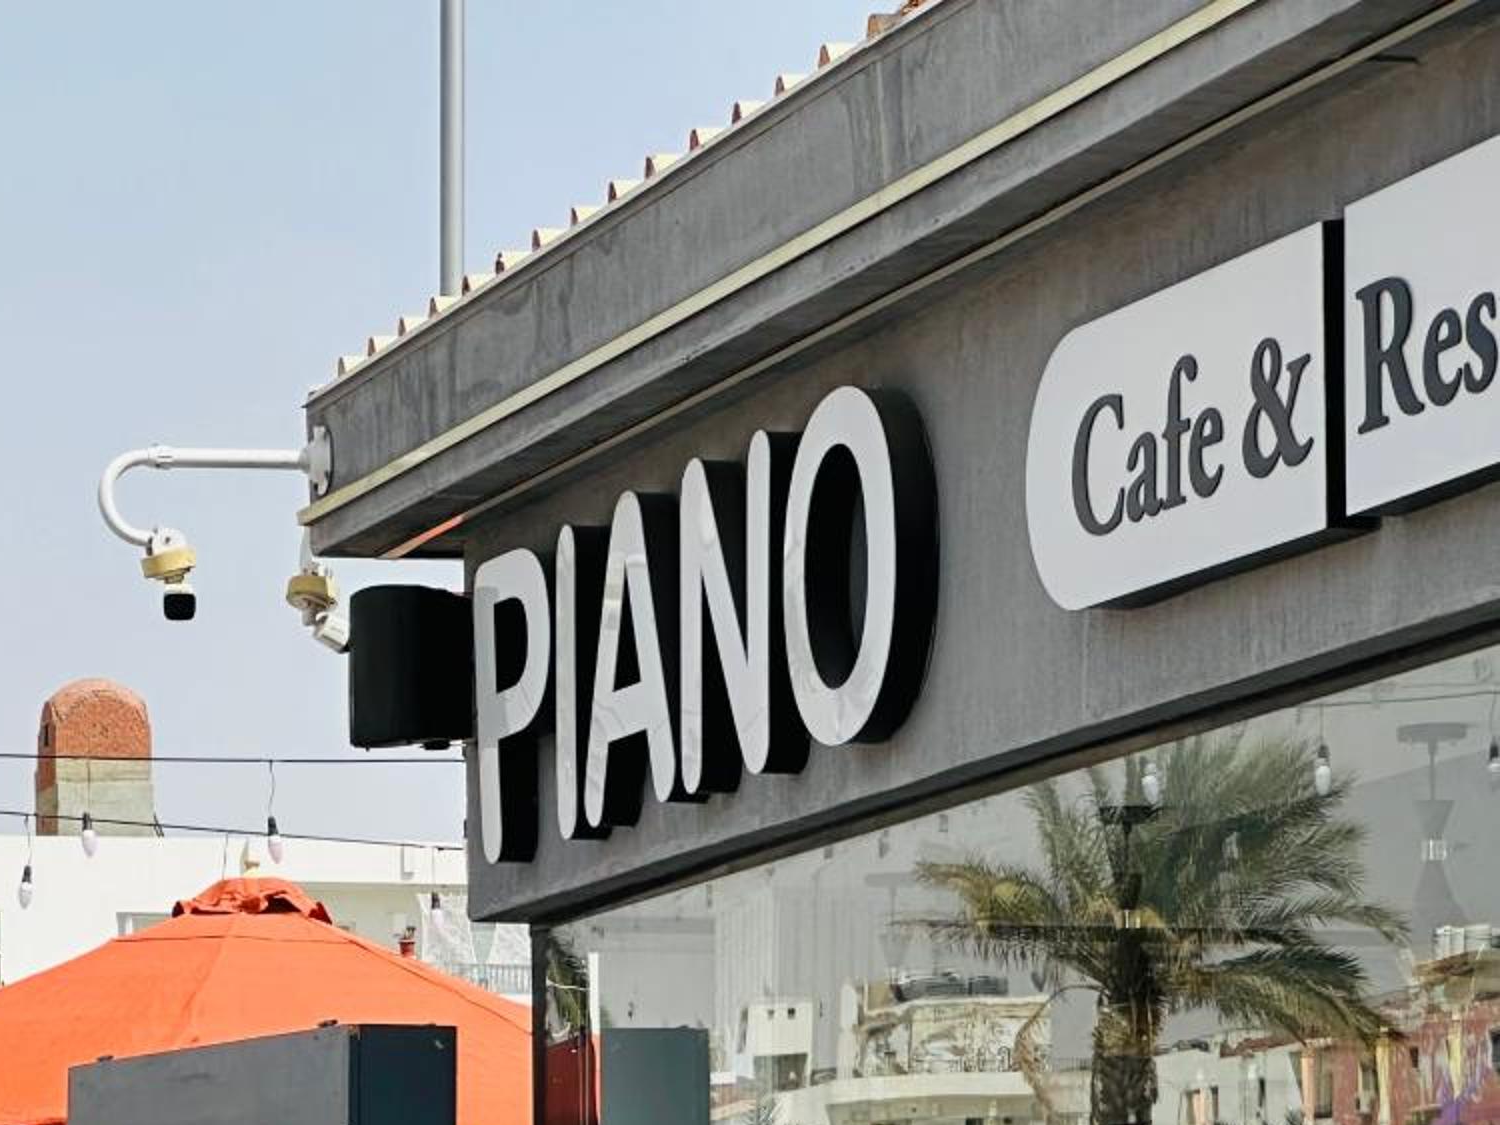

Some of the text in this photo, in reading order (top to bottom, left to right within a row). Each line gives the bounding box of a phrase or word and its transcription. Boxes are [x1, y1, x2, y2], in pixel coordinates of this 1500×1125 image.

[1070, 353, 1225, 538] Cafe
[1241, 336, 1315, 480] &
[474, 384, 898, 864] PIANO
